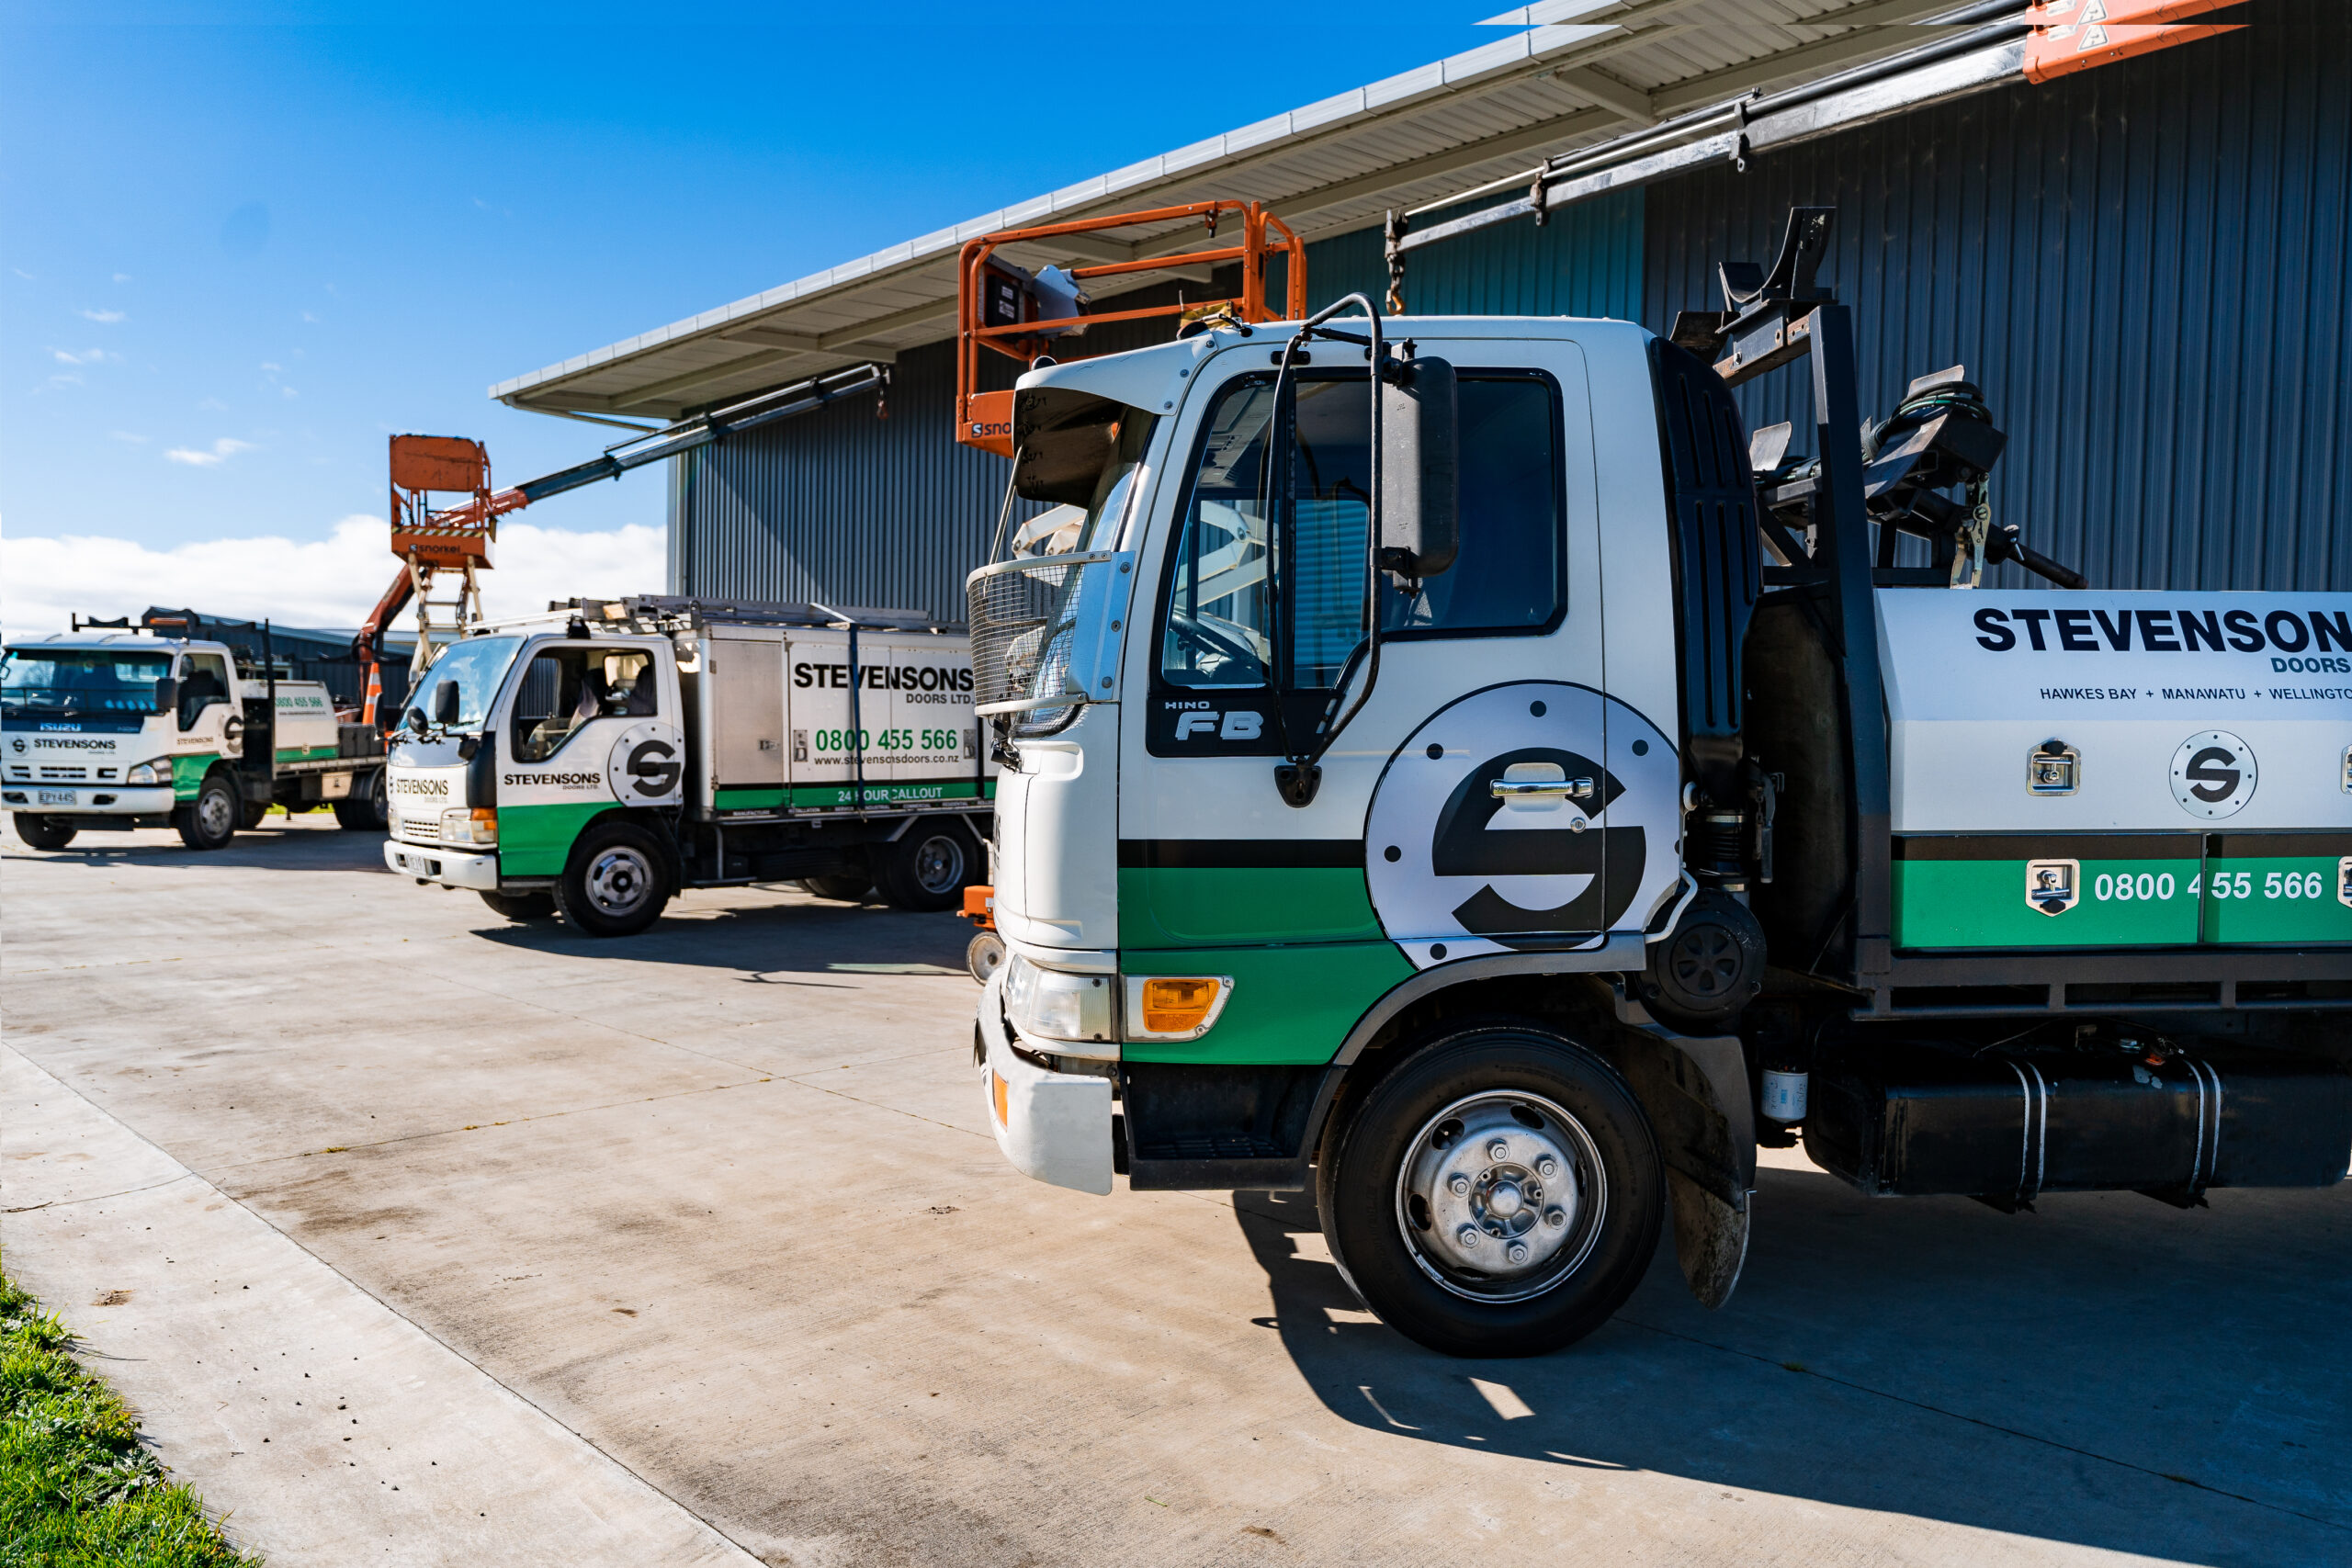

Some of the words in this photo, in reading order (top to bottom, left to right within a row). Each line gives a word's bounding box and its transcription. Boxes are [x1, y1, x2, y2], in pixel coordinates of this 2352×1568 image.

[1973, 607, 2352, 653] STEVENSON
[2270, 657, 2351, 673] DOORS
[793, 662, 974, 692] STEVENSONS
[906, 694, 947, 704] DOORS
[951, 694, 974, 705] LTD.
[2040, 688, 2104, 700] HAWKES
[2109, 688, 2137, 700] BAY
[2161, 688, 2245, 700] MANAWATU
[1165, 701, 1210, 709] HINO
[40, 722, 81, 731] ISUZU
[1174, 711, 1264, 740] FB
[34, 738, 117, 750] STEVENSONS
[816, 729, 870, 751] 0800
[877, 729, 913, 750] 455
[921, 729, 957, 750] 566
[503, 773, 601, 785] STEVENSONS
[396, 778, 448, 795] STEVENSONS
[838, 790, 852, 802] 24
[2094, 874, 2176, 901] 0800
[2264, 872, 2323, 899] 566
